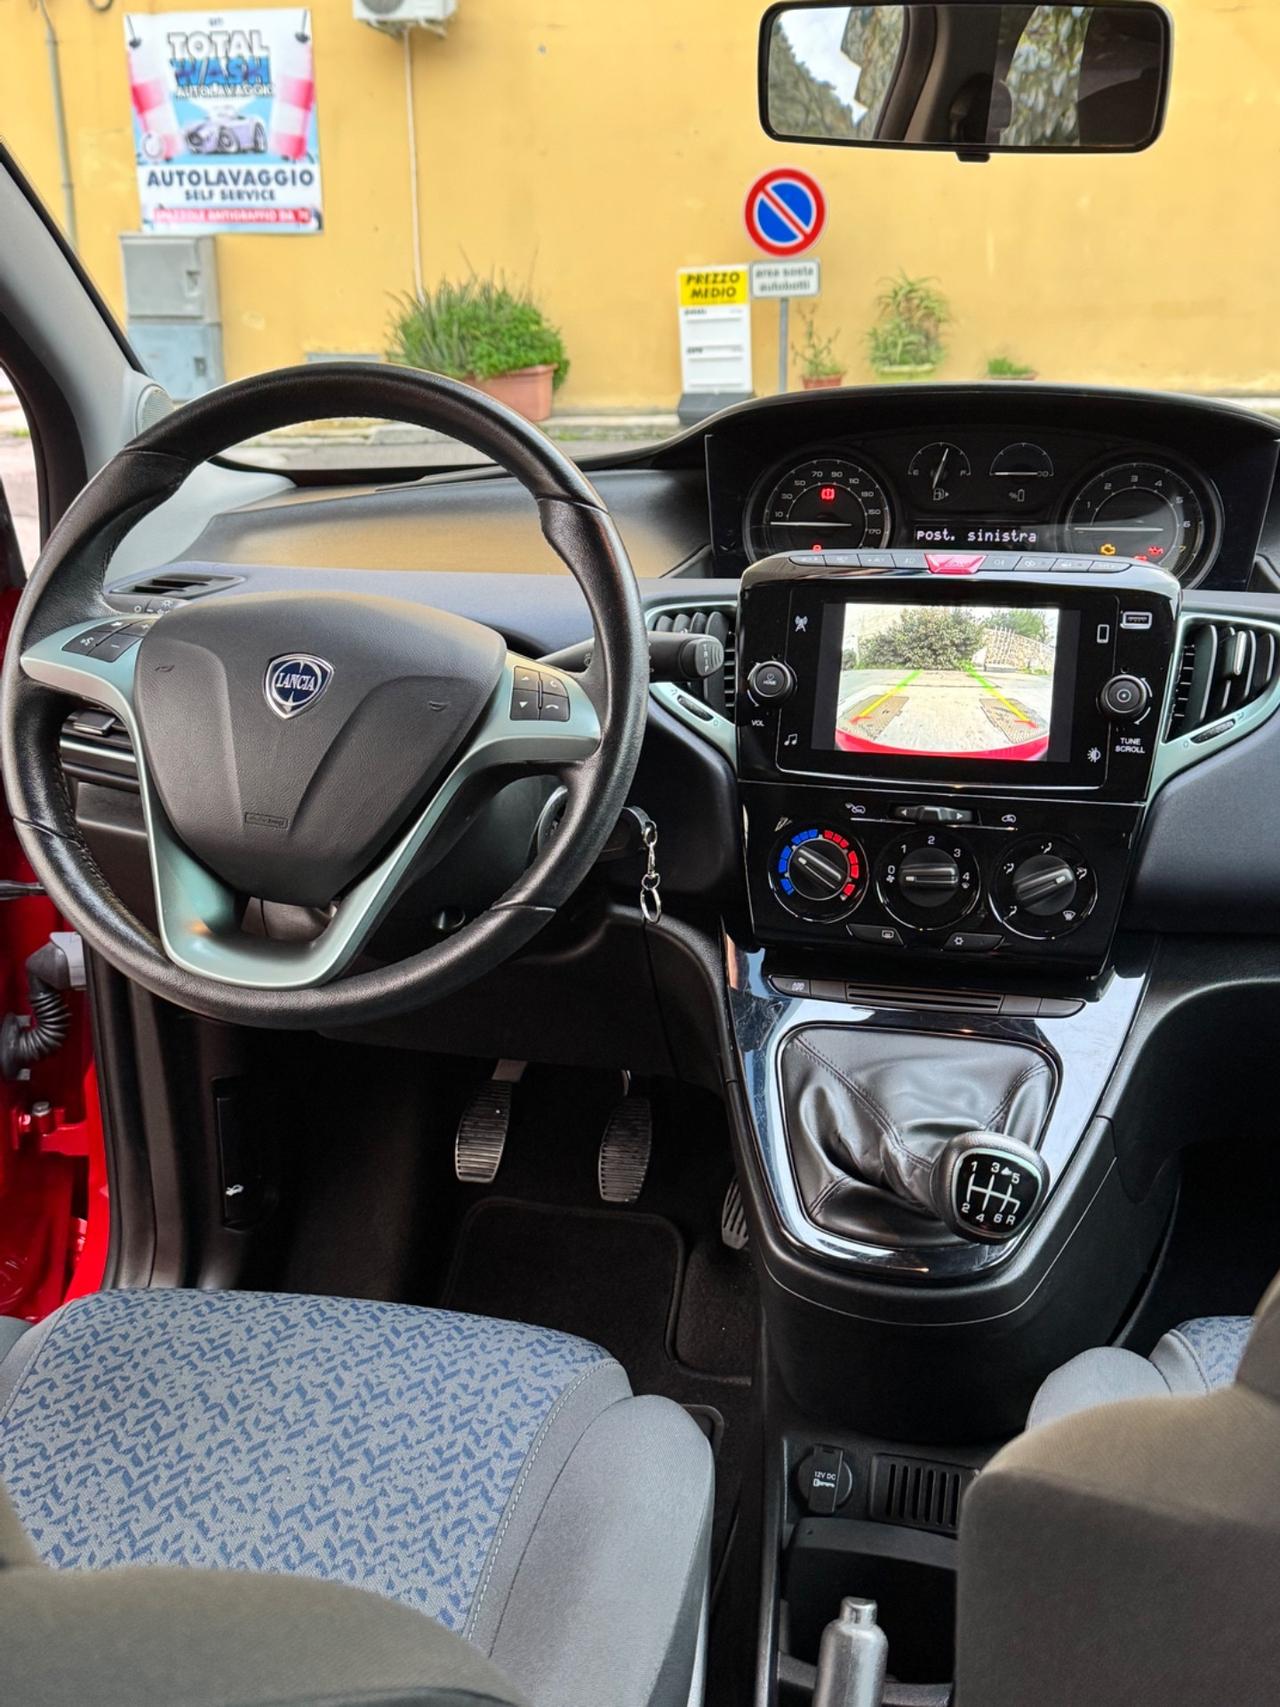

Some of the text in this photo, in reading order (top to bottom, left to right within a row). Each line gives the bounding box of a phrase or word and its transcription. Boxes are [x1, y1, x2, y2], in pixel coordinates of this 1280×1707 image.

[167, 30, 271, 59] TOTAL
[170, 55, 271, 87] WASH
[147, 169, 315, 187] AUTOLAVAGGIO
[185, 188, 277, 201] SELF SERVICE
[686, 271, 741, 286] PREZZO
[690, 287, 737, 299] MEDIO
[967, 528, 1038, 543] sinistra
[275, 672, 316, 692] LANCIA
[751, 719, 765, 727] VOL
[1120, 737, 1141, 746] TUNE
[1115, 744, 1146, 754] SCROLL
[927, 835, 936, 845] 2
[901, 844, 907, 854] 1
[953, 848, 961, 858] 3
[962, 871, 970, 881] 4
[971, 1161, 1021, 1184] 1 3 5
[961, 1202, 1016, 1226] 2 4 6 R
[814, 1470, 825, 1478] 12V
